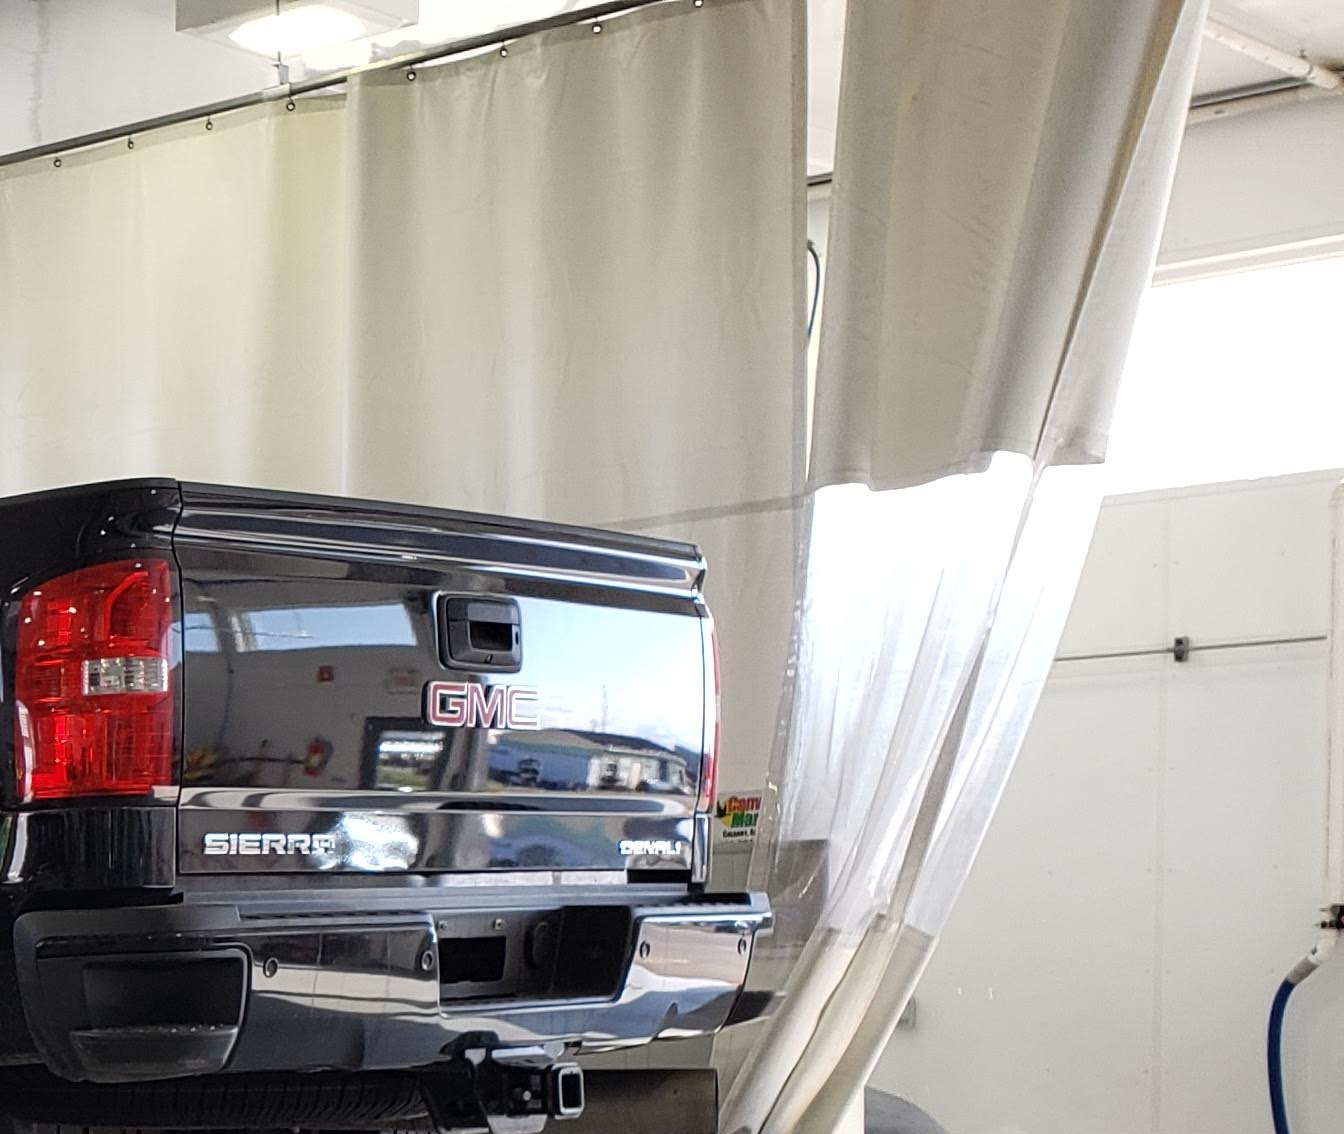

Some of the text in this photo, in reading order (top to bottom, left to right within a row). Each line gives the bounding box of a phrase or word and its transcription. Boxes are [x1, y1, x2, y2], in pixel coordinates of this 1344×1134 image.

[428, 680, 541, 730] GMC
[203, 832, 336, 856] SIERRA
[618, 840, 682, 856] DENALI
